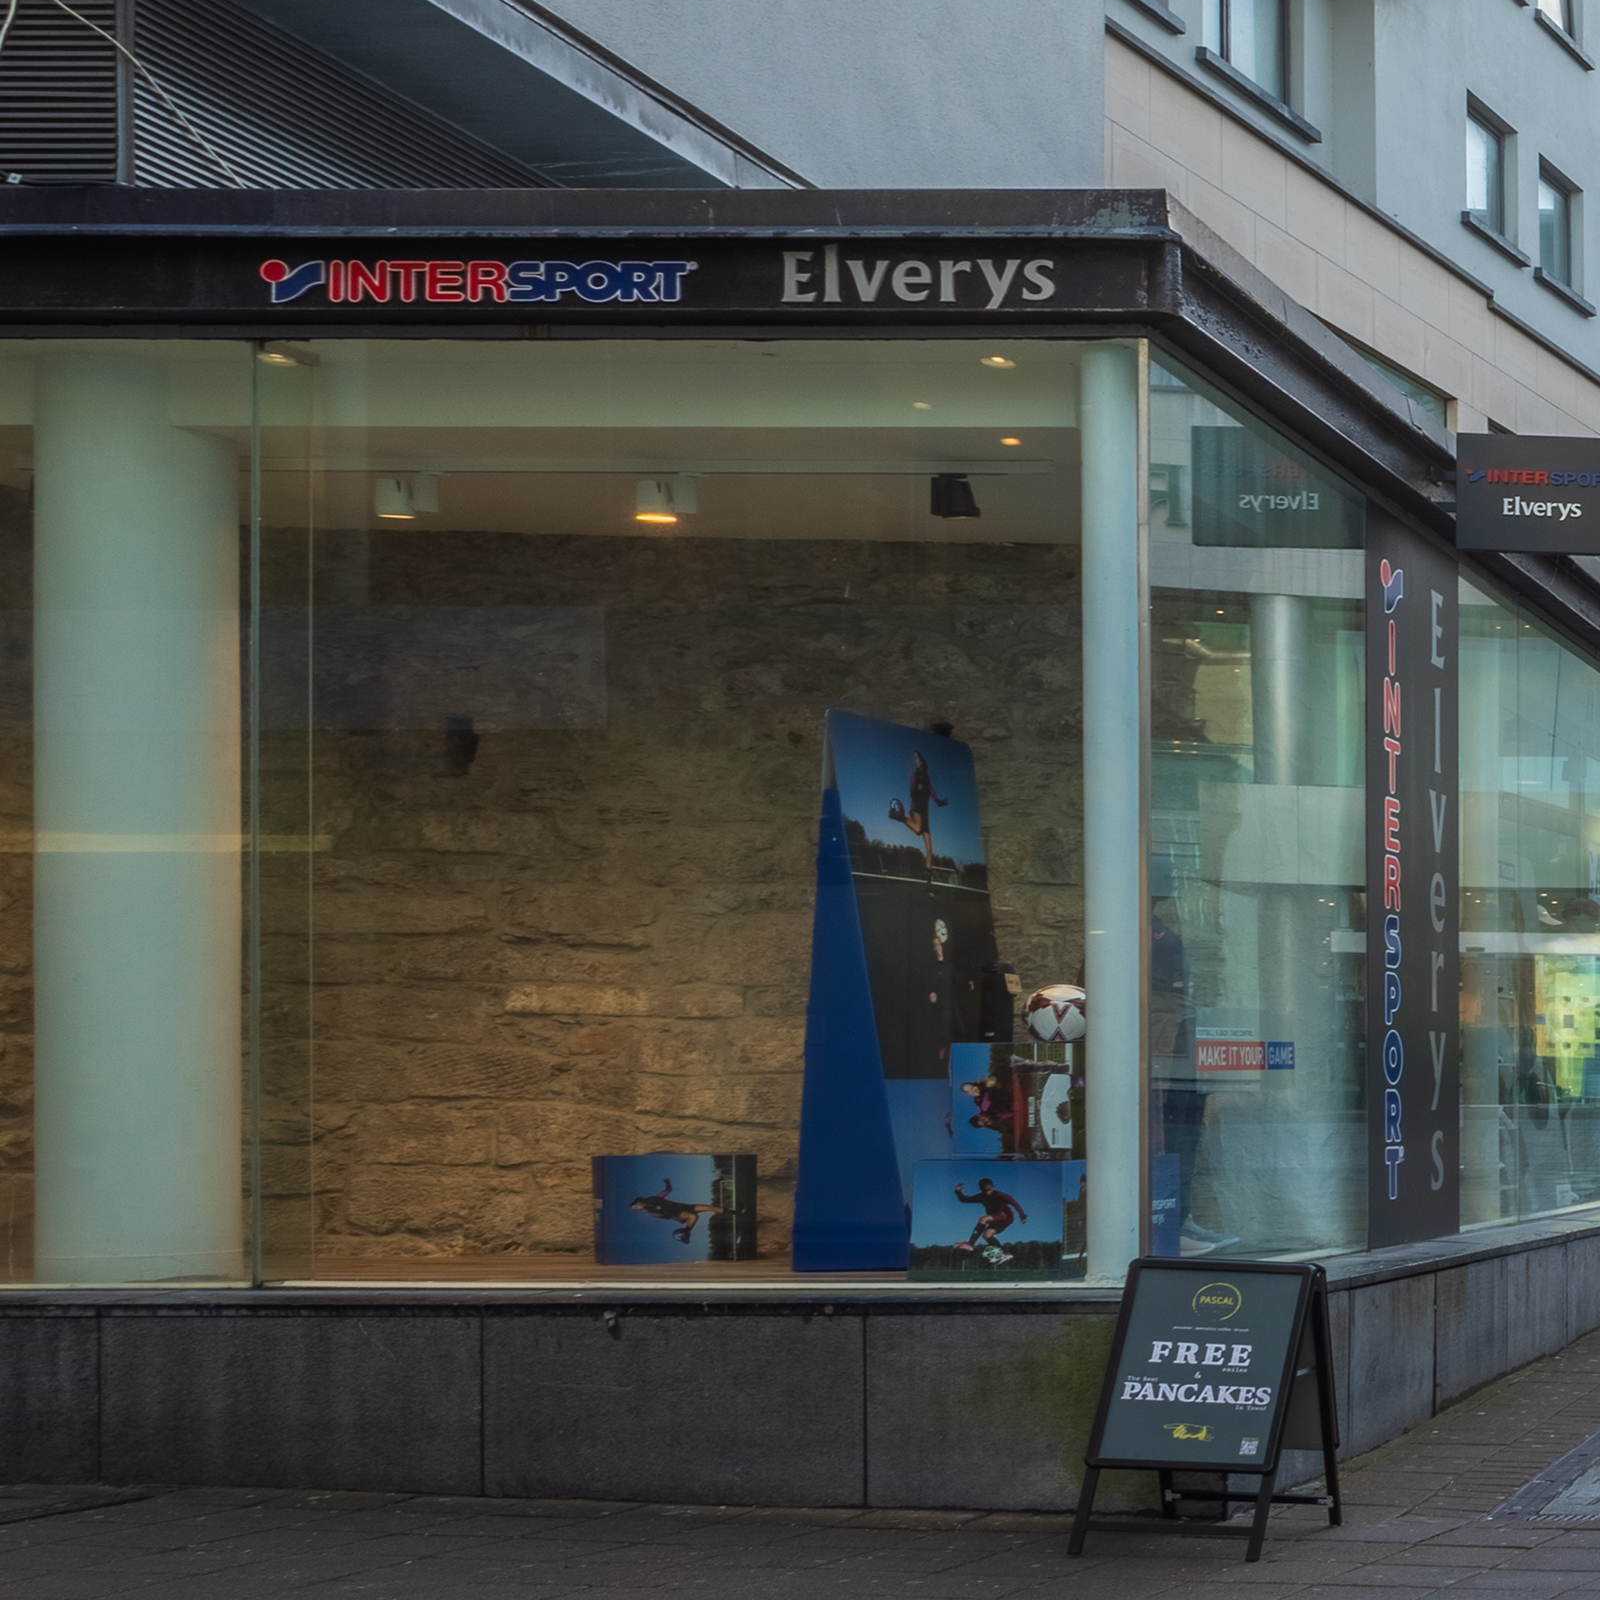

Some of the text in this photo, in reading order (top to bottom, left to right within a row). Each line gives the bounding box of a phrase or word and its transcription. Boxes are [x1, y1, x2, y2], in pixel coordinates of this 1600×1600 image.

[328, 244, 1056, 310] INTERSPORT Elverys
[1502, 496, 1583, 520] Elverys
[1429, 589, 1447, 1191] Elverys
[1380, 619, 1403, 1201] INTERSPORT
[1198, 1046, 1294, 1066] MAKE IT YOUR GAME
[1200, 1295, 1234, 1306] PASCAL
[1148, 1340, 1253, 1367] FREE
[1194, 1371, 1201, 1379] &
[1120, 1381, 1272, 1406] PANCAKES
